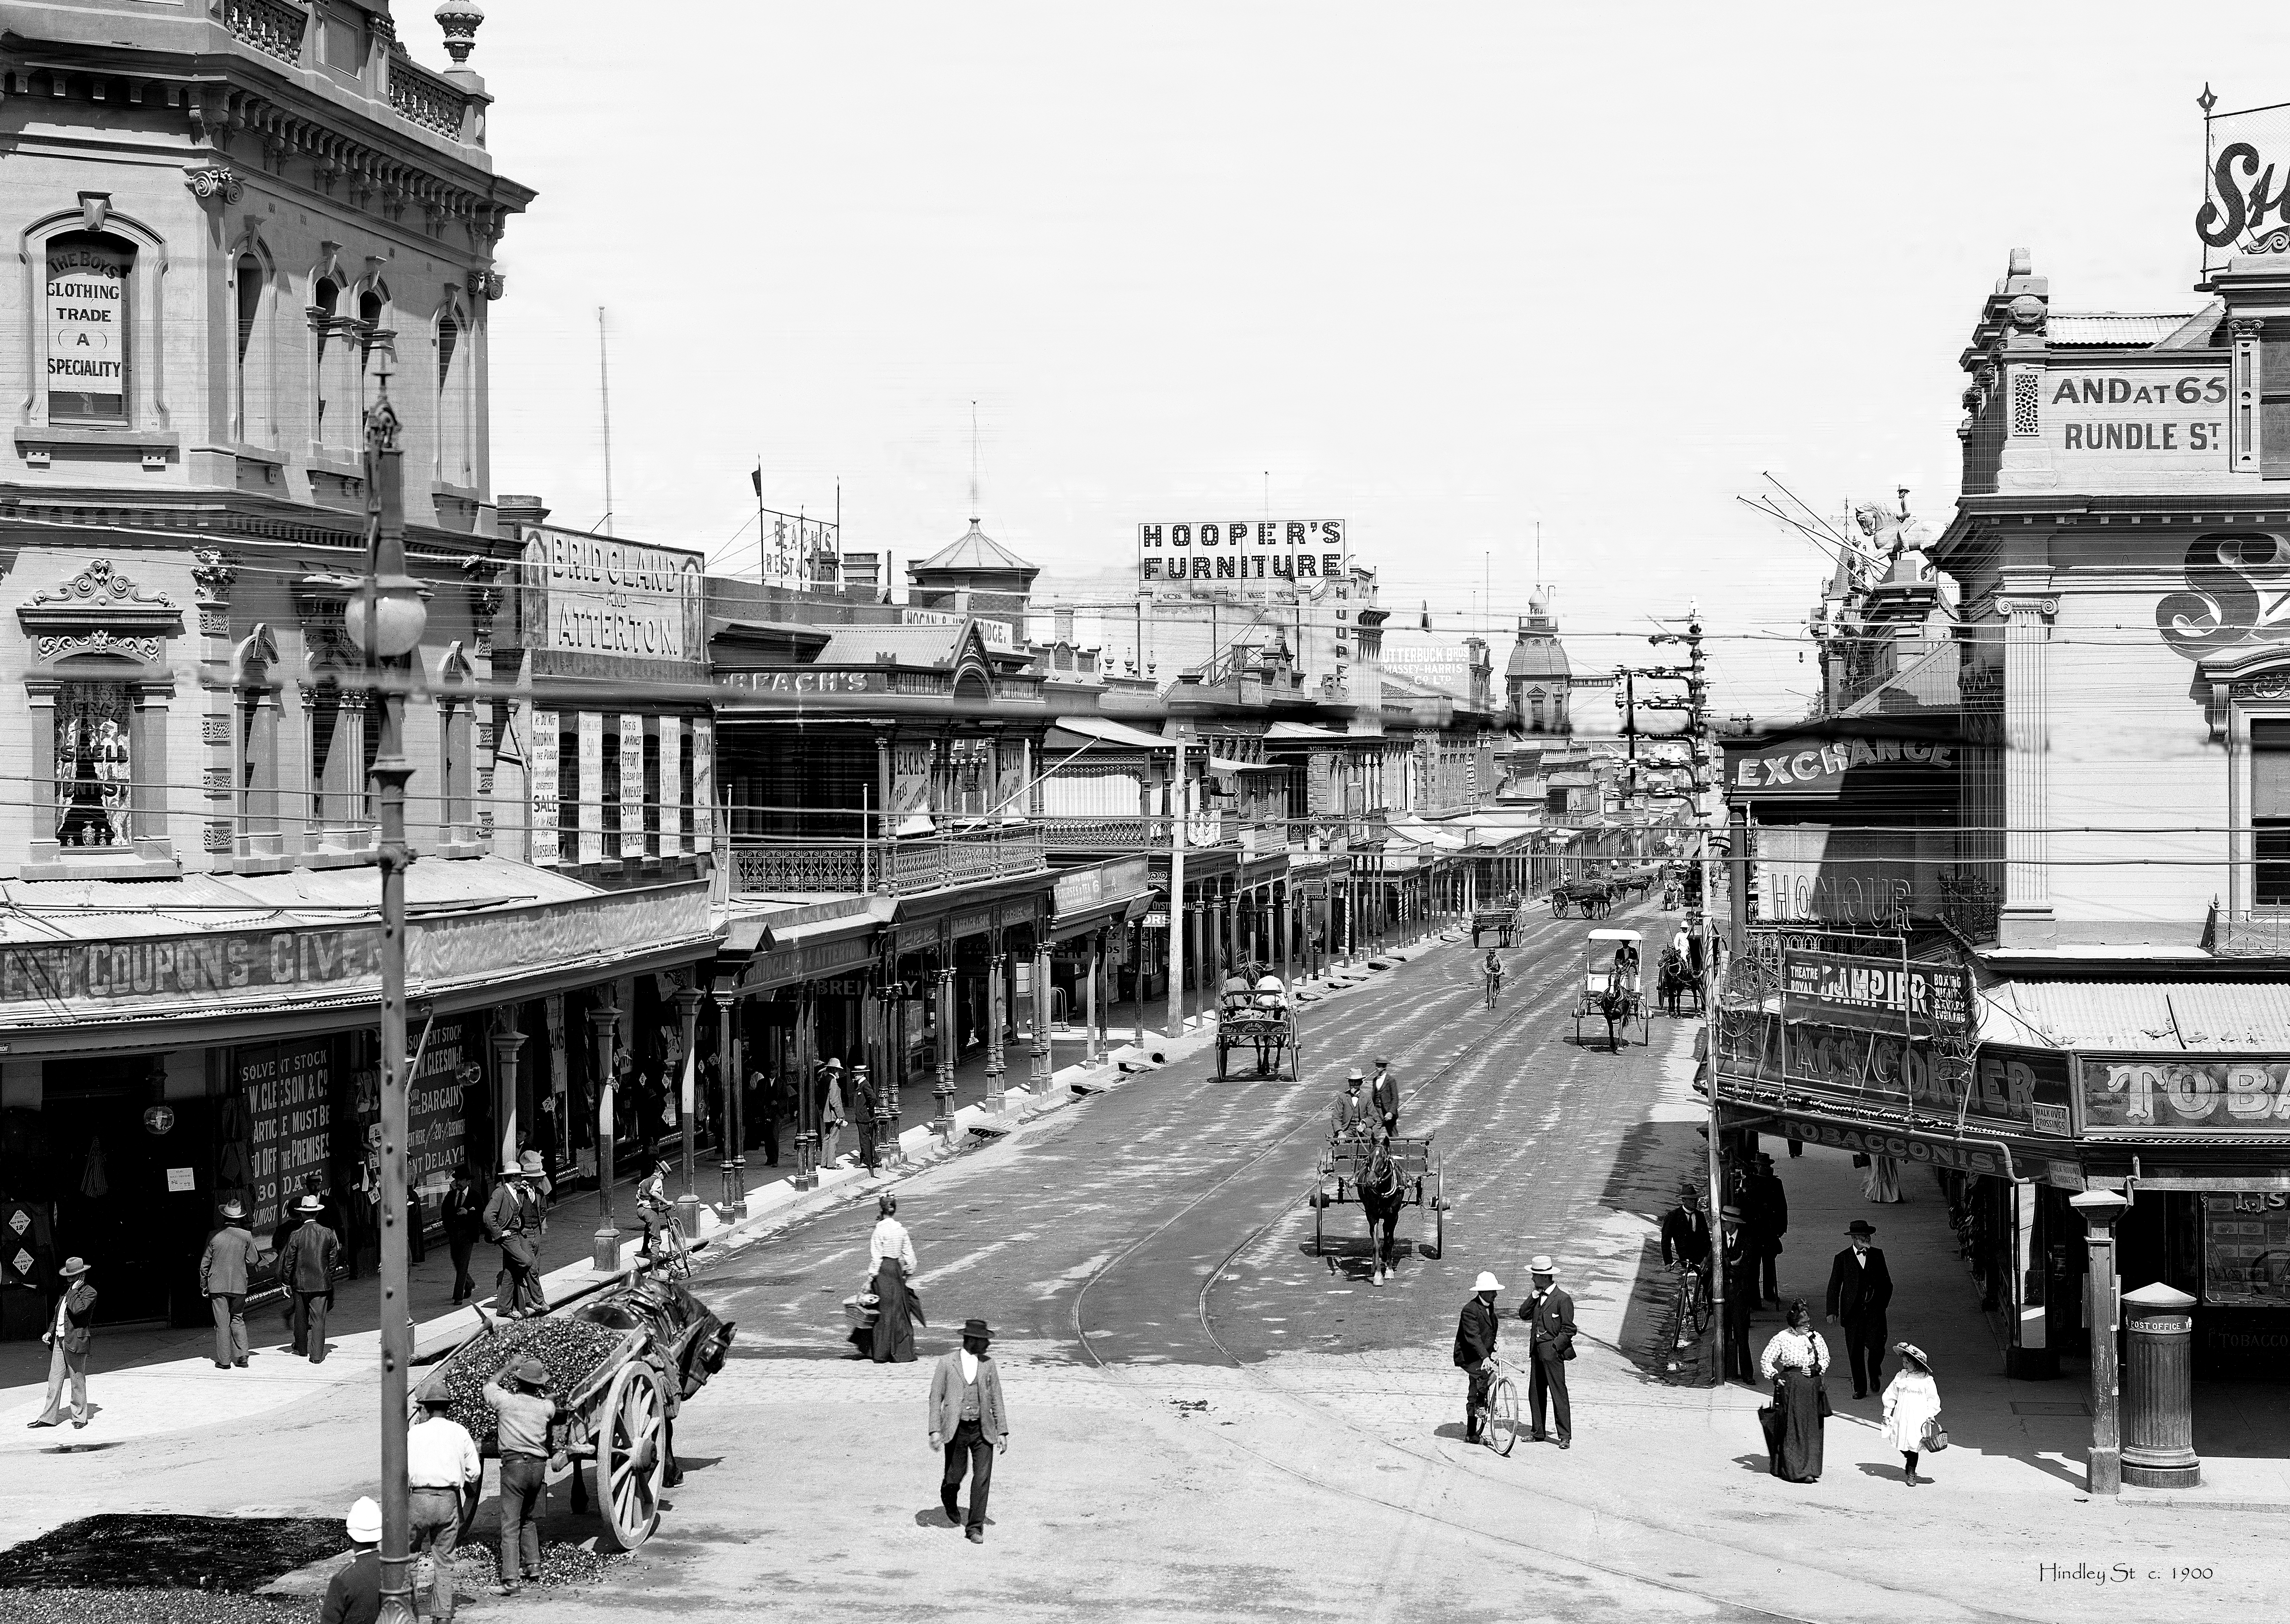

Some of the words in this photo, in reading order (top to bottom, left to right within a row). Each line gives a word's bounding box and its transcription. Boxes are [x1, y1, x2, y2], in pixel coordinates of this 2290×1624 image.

[47, 252, 79, 273] THE
[80, 251, 119, 279] BOYS
[47, 283, 119, 299] CLOTHING
[56, 307, 111, 322] TRADE
[76, 333, 90, 346] A
[48, 358, 121, 378] SPECIALITY
[2052, 378, 2131, 404] AND
[2134, 384, 2170, 404] AT
[2175, 377, 2228, 404] 65
[2065, 423, 2178, 450] RUNDLE
[1144, 522, 1341, 547] HOOPER'S
[1144, 554, 1341, 579] FURNITURE
[1381, 648, 1443, 663] UTTERBUCK
[622, 720, 631, 730] THIS
[533, 730, 555, 746] HOODWINK
[544, 749, 557, 759] PUBLIC
[622, 751, 639, 769] EFFORT
[1737, 738, 1953, 787] EXCHANGE
[622, 785, 642, 797] IMMENSE
[533, 795, 557, 812] SALE
[622, 802, 639, 817] STOCK
[546, 816, 557, 826] VALUE
[622, 832, 643, 849] PREMISES
[1771, 874, 1913, 931] HONOUR
[89, 937, 249, 996] COUPONS
[1790, 965, 1818, 980] THEATRE
[1791, 980, 1814, 993] ROYAL
[442, 1024, 462, 1043] STOCK
[294, 1049, 327, 1070] STOCK
[1874, 1034, 2036, 1111] CORNER
[308, 1074, 315, 1099] &
[421, 1084, 464, 1114] BARGAINS
[2036, 1108, 2050, 1118] WALK
[2051, 1109, 2066, 1120] OVER
[253, 1115, 288, 1144] ARTICE
[292, 1107, 317, 1134] MUST
[320, 1104, 330, 1126] BE
[2036, 1119, 2066, 1129] CROSSINGS
[415, 1128, 426, 1146] HERE
[262, 1147, 277, 1176] OFF
[281, 1150, 291, 1171] THE
[2063, 1165, 2080, 1176] ROUND
[258, 1182, 276, 1202] 30
[282, 1168, 322, 1195] DAS
[2130, 1320, 2150, 1330] POST
[2218, 1332, 2288, 1348] TOBACCO
